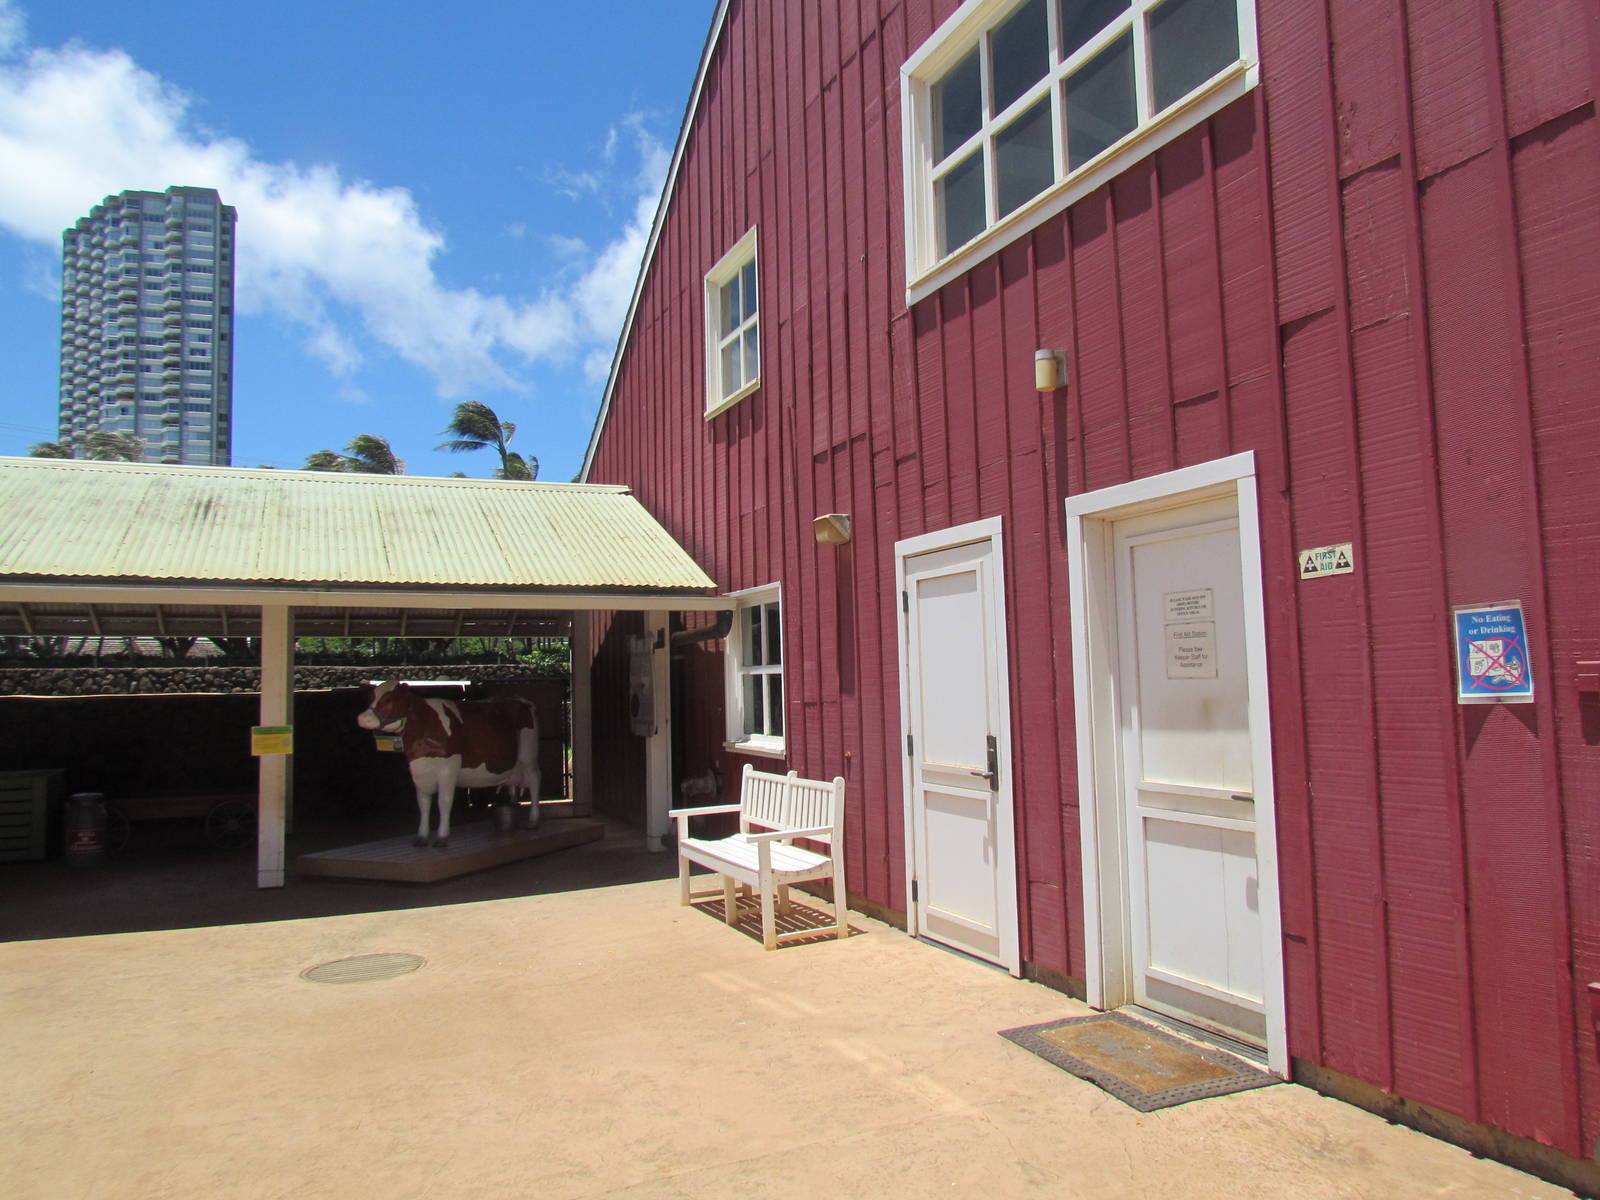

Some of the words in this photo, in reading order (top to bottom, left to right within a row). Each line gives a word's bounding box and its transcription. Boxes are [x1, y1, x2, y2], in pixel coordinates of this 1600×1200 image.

[1315, 551, 1336, 560] FIRST
[1320, 562, 1333, 570] AID
[1485, 614, 1512, 623] Eating
[1480, 625, 1516, 634] Drinking
